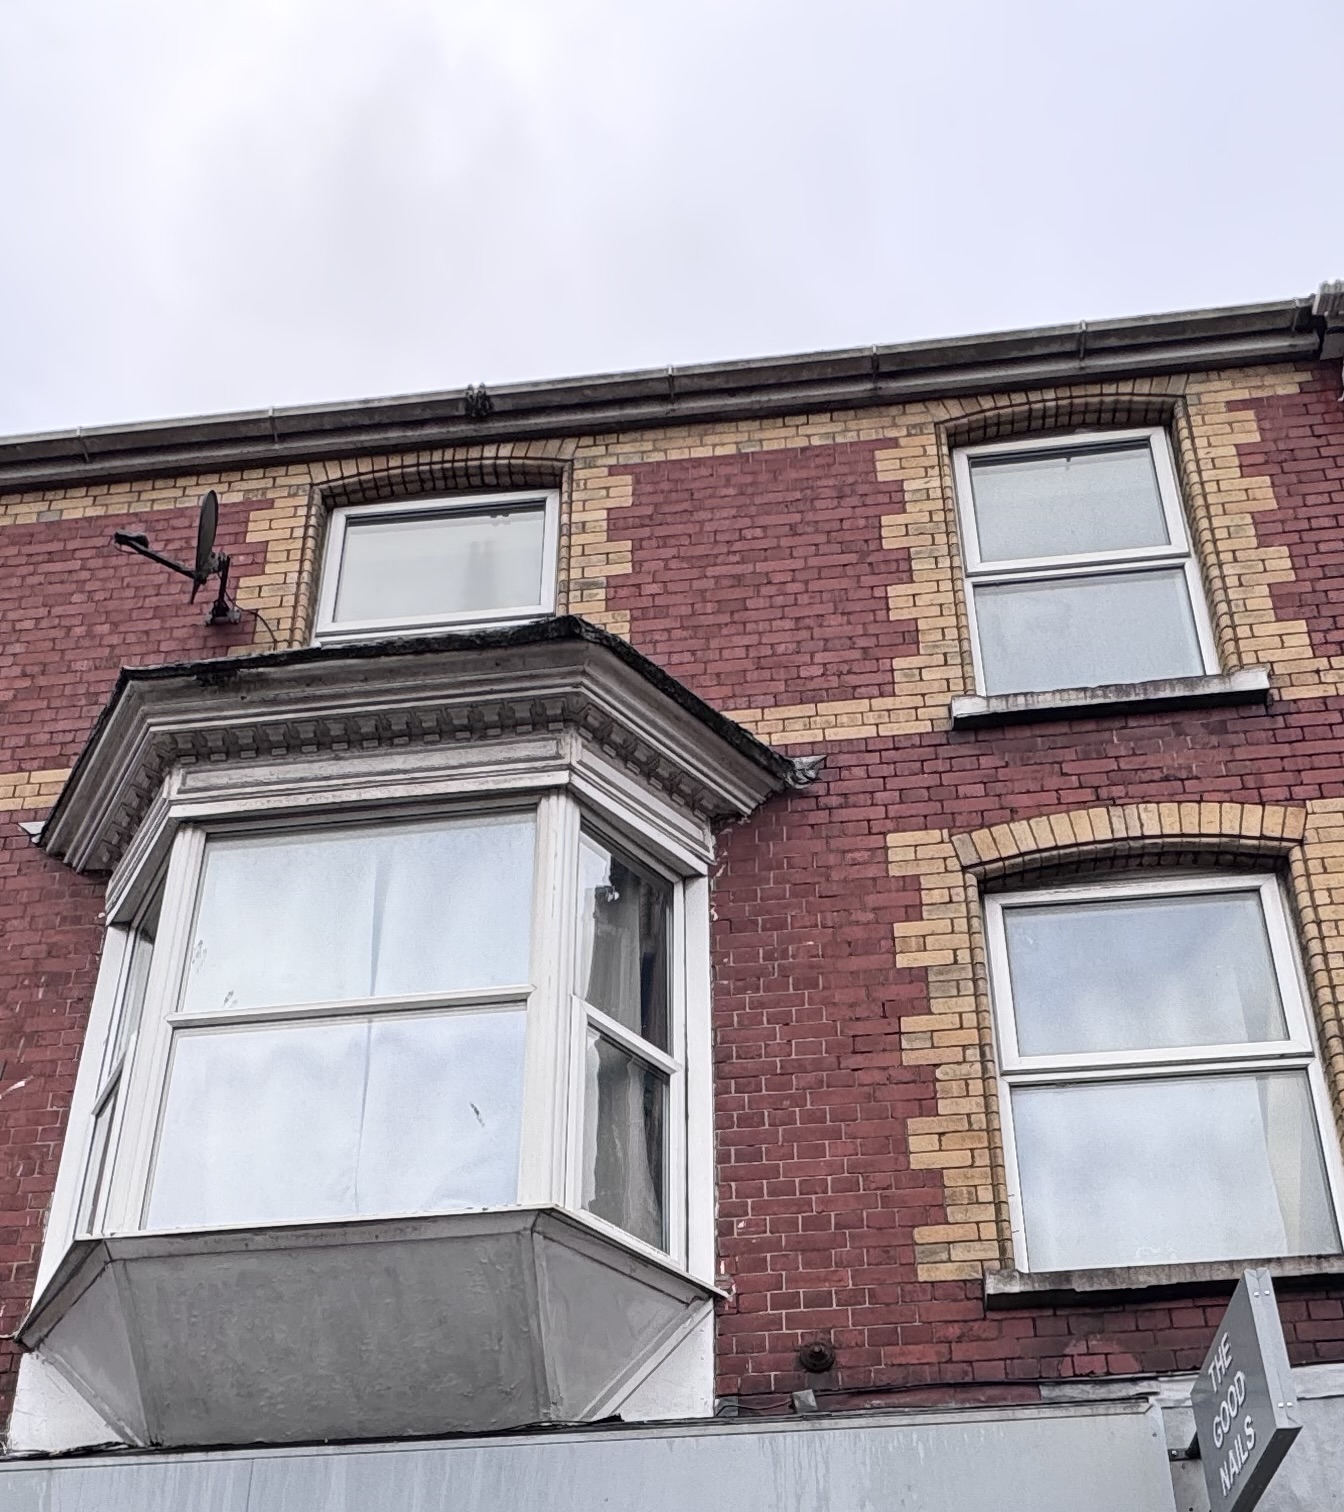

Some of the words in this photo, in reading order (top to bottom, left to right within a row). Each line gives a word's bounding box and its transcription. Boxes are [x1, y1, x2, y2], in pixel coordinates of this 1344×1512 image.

[1207, 1331, 1234, 1393] THE
[1212, 1370, 1247, 1449] GOOD
[1219, 1414, 1256, 1497] NAILS
